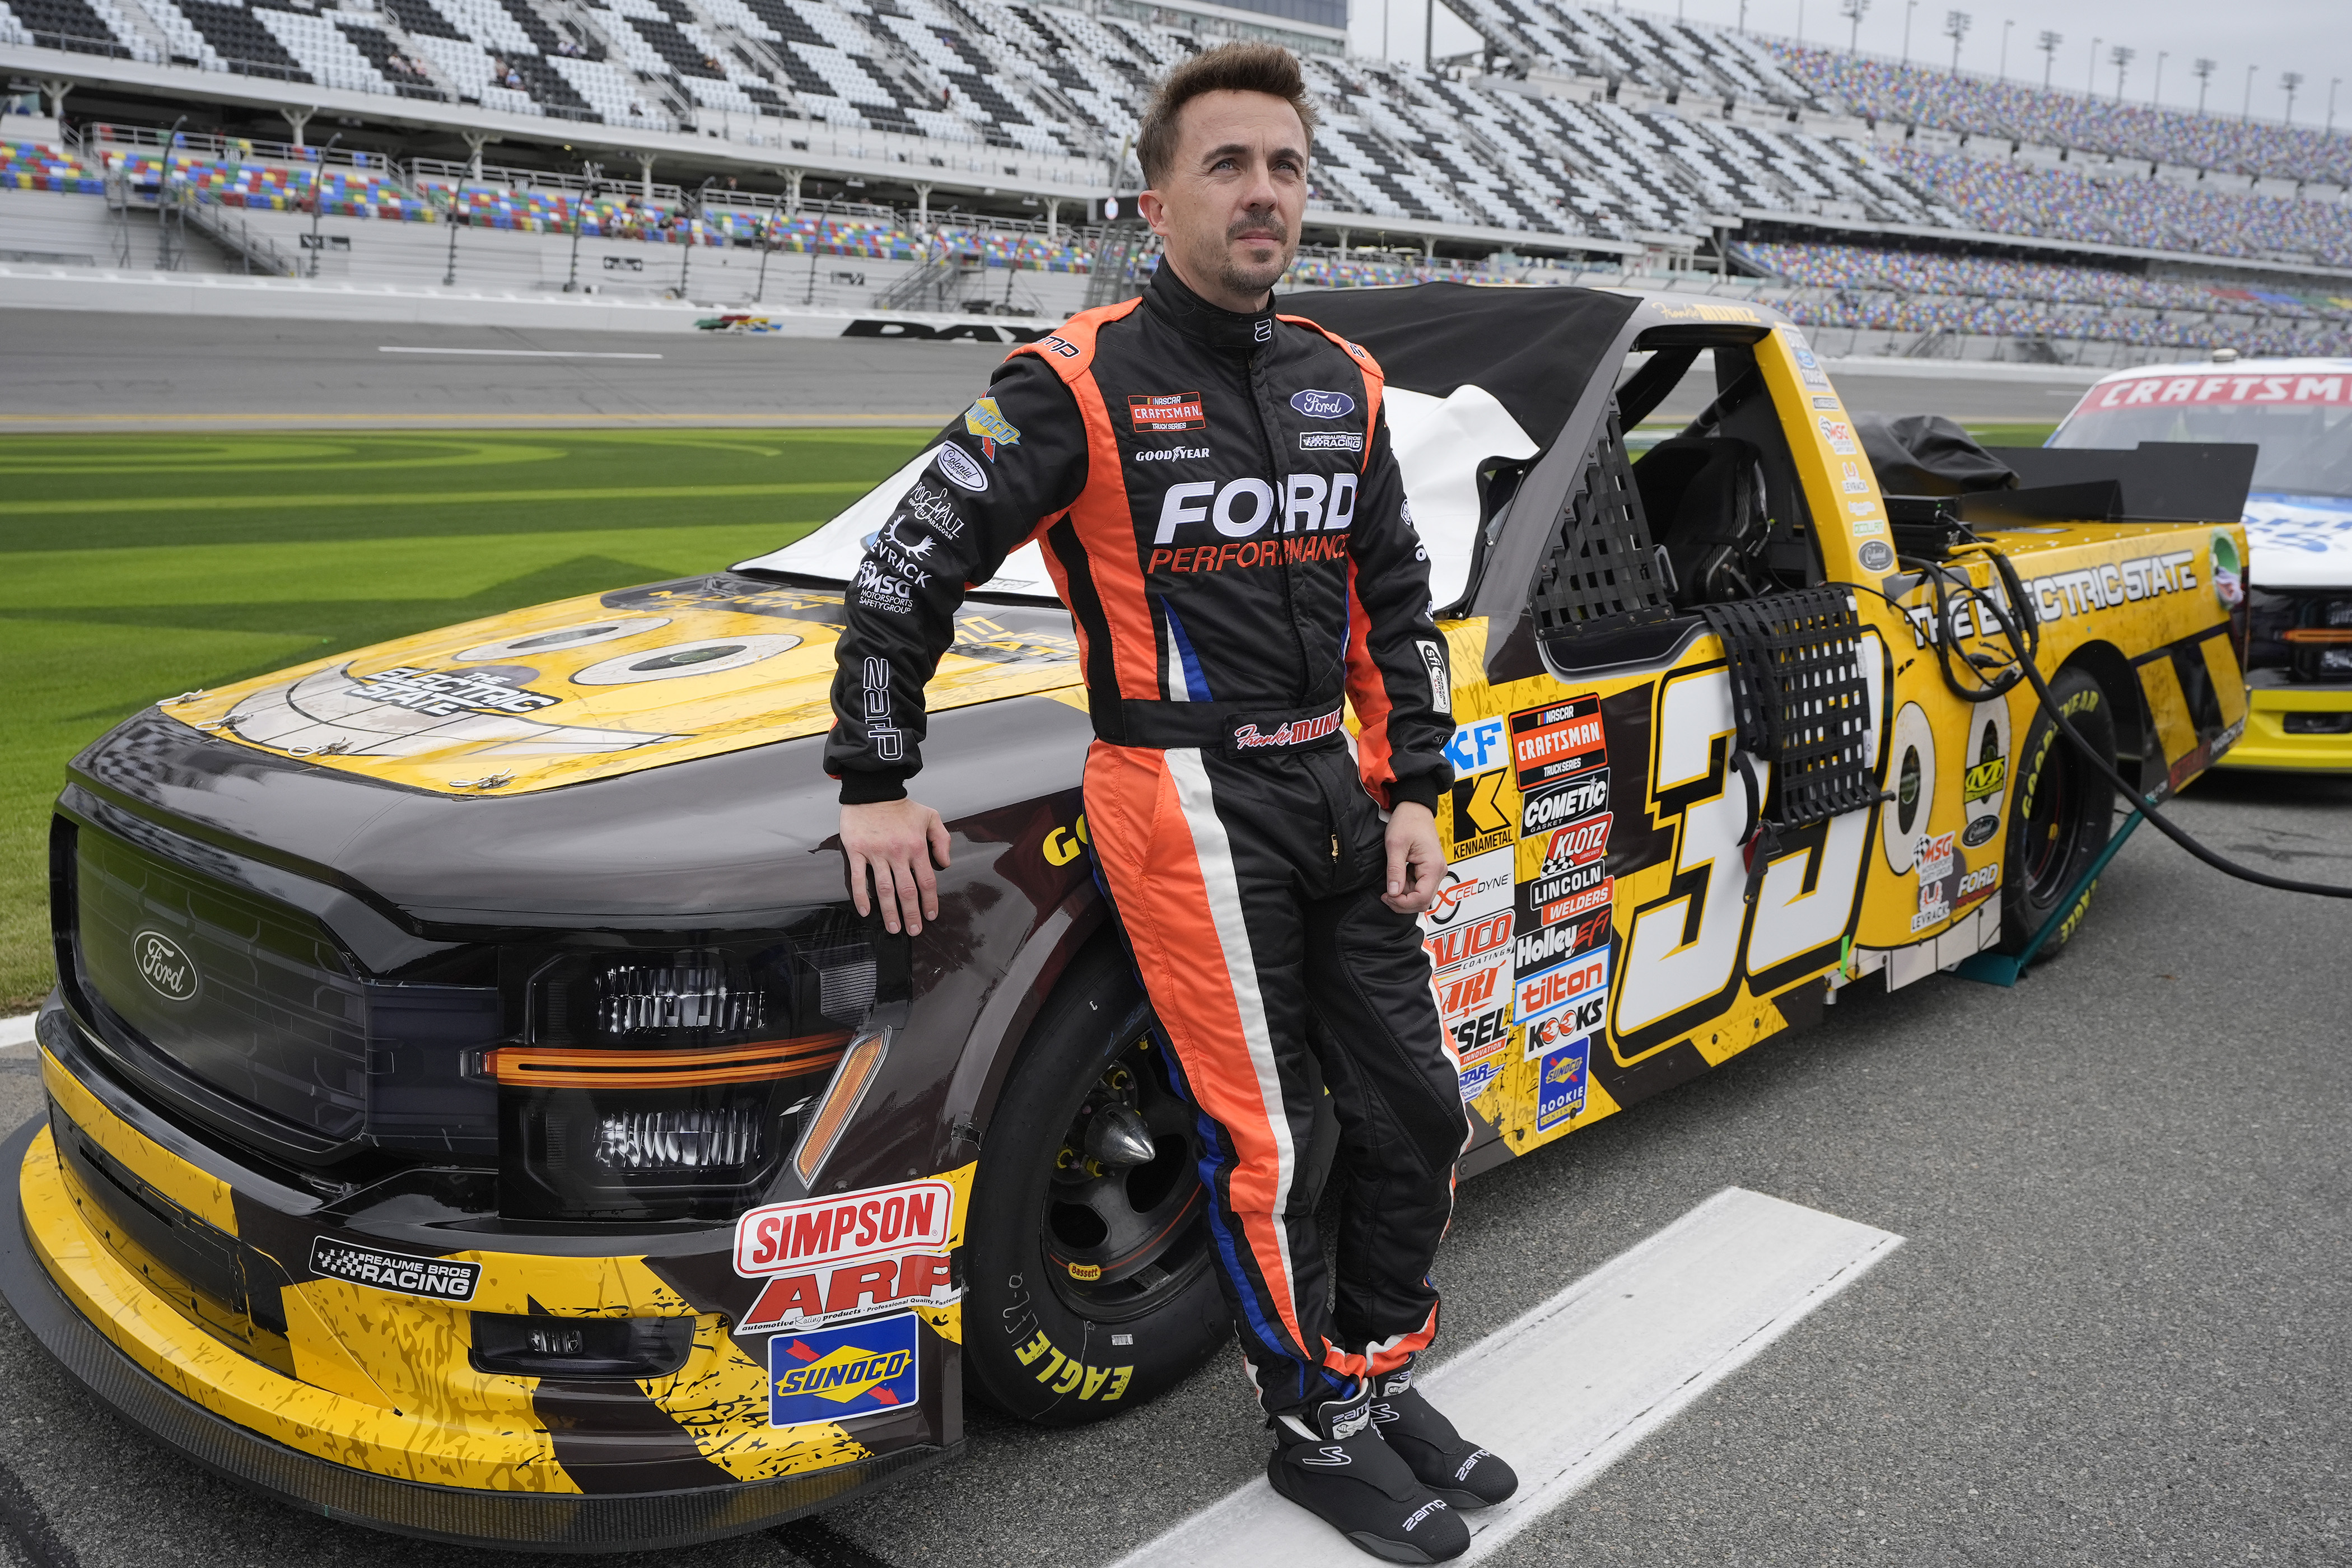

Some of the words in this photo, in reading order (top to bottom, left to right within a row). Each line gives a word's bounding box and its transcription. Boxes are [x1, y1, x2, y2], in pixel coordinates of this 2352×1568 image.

[1034, 335, 1080, 358] mp
[1153, 396, 1181, 405] NASCAR
[1303, 393, 1342, 414] Ford
[2099, 377, 2352, 407] CRAFTSM
[968, 402, 1016, 442] UNOCO
[1135, 405, 1201, 419] CRAFTSMAN
[1323, 438, 1361, 449] RACING
[942, 449, 978, 479] Colonial
[1153, 473, 1359, 544] FORD
[870, 536, 933, 589] EVRACK
[2121, 550, 2197, 601] STATE
[861, 573, 912, 599] MSG
[861, 589, 913, 608] MOTORSPORTS
[1426, 649, 1441, 666] sfi
[365, 668, 555, 712] ELECTRIC
[464, 671, 511, 685] THE
[351, 682, 476, 716] STATE
[1546, 705, 1574, 725] NASCAR
[1234, 722, 1294, 749] Frankie
[1443, 722, 1502, 771] KF
[1518, 722, 1600, 762] CRAFTSMAN
[1543, 763, 1562, 778] TRUCK
[1562, 758, 1581, 773] SERIES
[1524, 781, 1607, 828] COMETIC
[1530, 818, 1562, 833] GASKET
[1553, 821, 1609, 860] KLOTZ
[1454, 830, 1513, 860] KENNAMETAL
[1534, 865, 1602, 903] LINCOLN
[1957, 863, 1999, 898] FORD
[1550, 886, 1608, 920] WELDERS
[1912, 905, 1950, 930] LEVRACK
[1431, 913, 1513, 968] ALICO
[1516, 925, 1578, 969] Holley
[143, 938, 185, 993] Ford
[1463, 946, 1512, 970] COATINGS
[1443, 959, 1506, 1015] ART
[1522, 963, 1602, 1014] tilton
[1528, 997, 1604, 1053] KOOKS
[1463, 1040, 1502, 1063] INNOVATION
[1547, 1058, 1581, 1082] SUNOCO
[1541, 1085, 1584, 1116] ROOKIE
[752, 1192, 935, 1264] SIMPSON
[361, 1264, 469, 1296] RACING
[364, 1254, 424, 1273] REAUME
[427, 1264, 472, 1278] BROS
[1071, 1265, 1098, 1278] Bassett
[744, 1256, 951, 1324] ARP
[742, 1319, 794, 1331] automotive
[794, 1315, 822, 1327] Racing
[822, 1308, 862, 1322] products
[866, 1299, 909, 1313] Professional
[909, 1298, 934, 1306] Quality
[782, 1352, 907, 1394] SUNOCO
[1014, 1329, 1135, 1401] EAGLE
[1454, 1449, 1491, 1482] zamp
[1402, 1499, 1447, 1532] zamp
